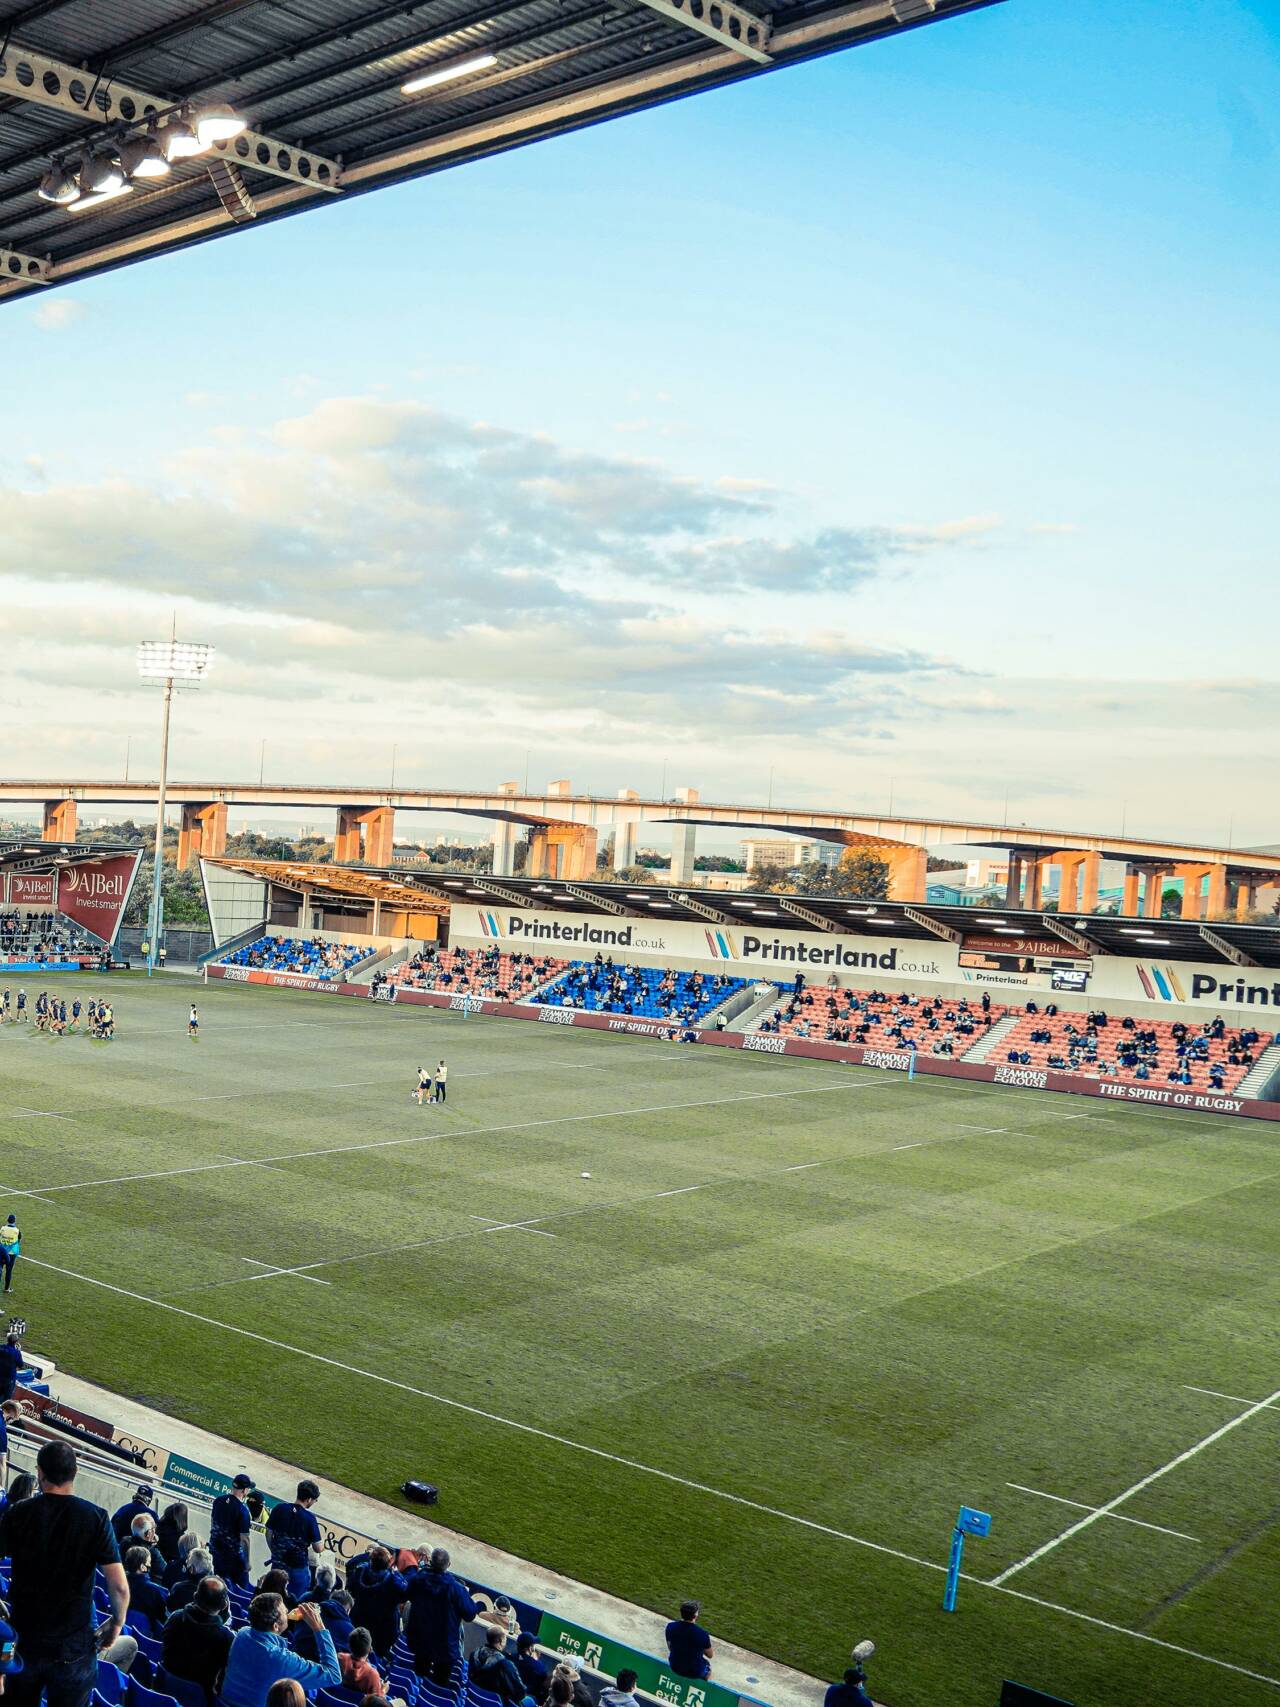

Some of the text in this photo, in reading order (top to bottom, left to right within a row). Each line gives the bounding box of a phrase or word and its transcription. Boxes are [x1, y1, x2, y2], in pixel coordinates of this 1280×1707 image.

[76, 896, 122, 910] Invest smart
[273, 976, 340, 992] THE SPIRIT OF RUGBY
[976, 973, 1029, 985] Printerland
[545, 1009, 575, 1018] FAMOUS
[627, 1021, 656, 1035] SPIRIT
[751, 1035, 787, 1047] FAMOUS
[749, 1042, 786, 1054] GROUSE
[869, 1058, 909, 1070] GROUSE
[870, 1051, 910, 1064] FAMOUS
[1003, 1068, 1048, 1080] FAMOUS
[1001, 1075, 1047, 1088] GROUSE
[1099, 1083, 1244, 1112] THE SPIRIT OF RUGBY
[169, 1461, 221, 1491] Commercial &
[559, 1631, 582, 1649] Fire
[658, 1674, 683, 1694] Fire
[655, 1689, 679, 1705] exit
